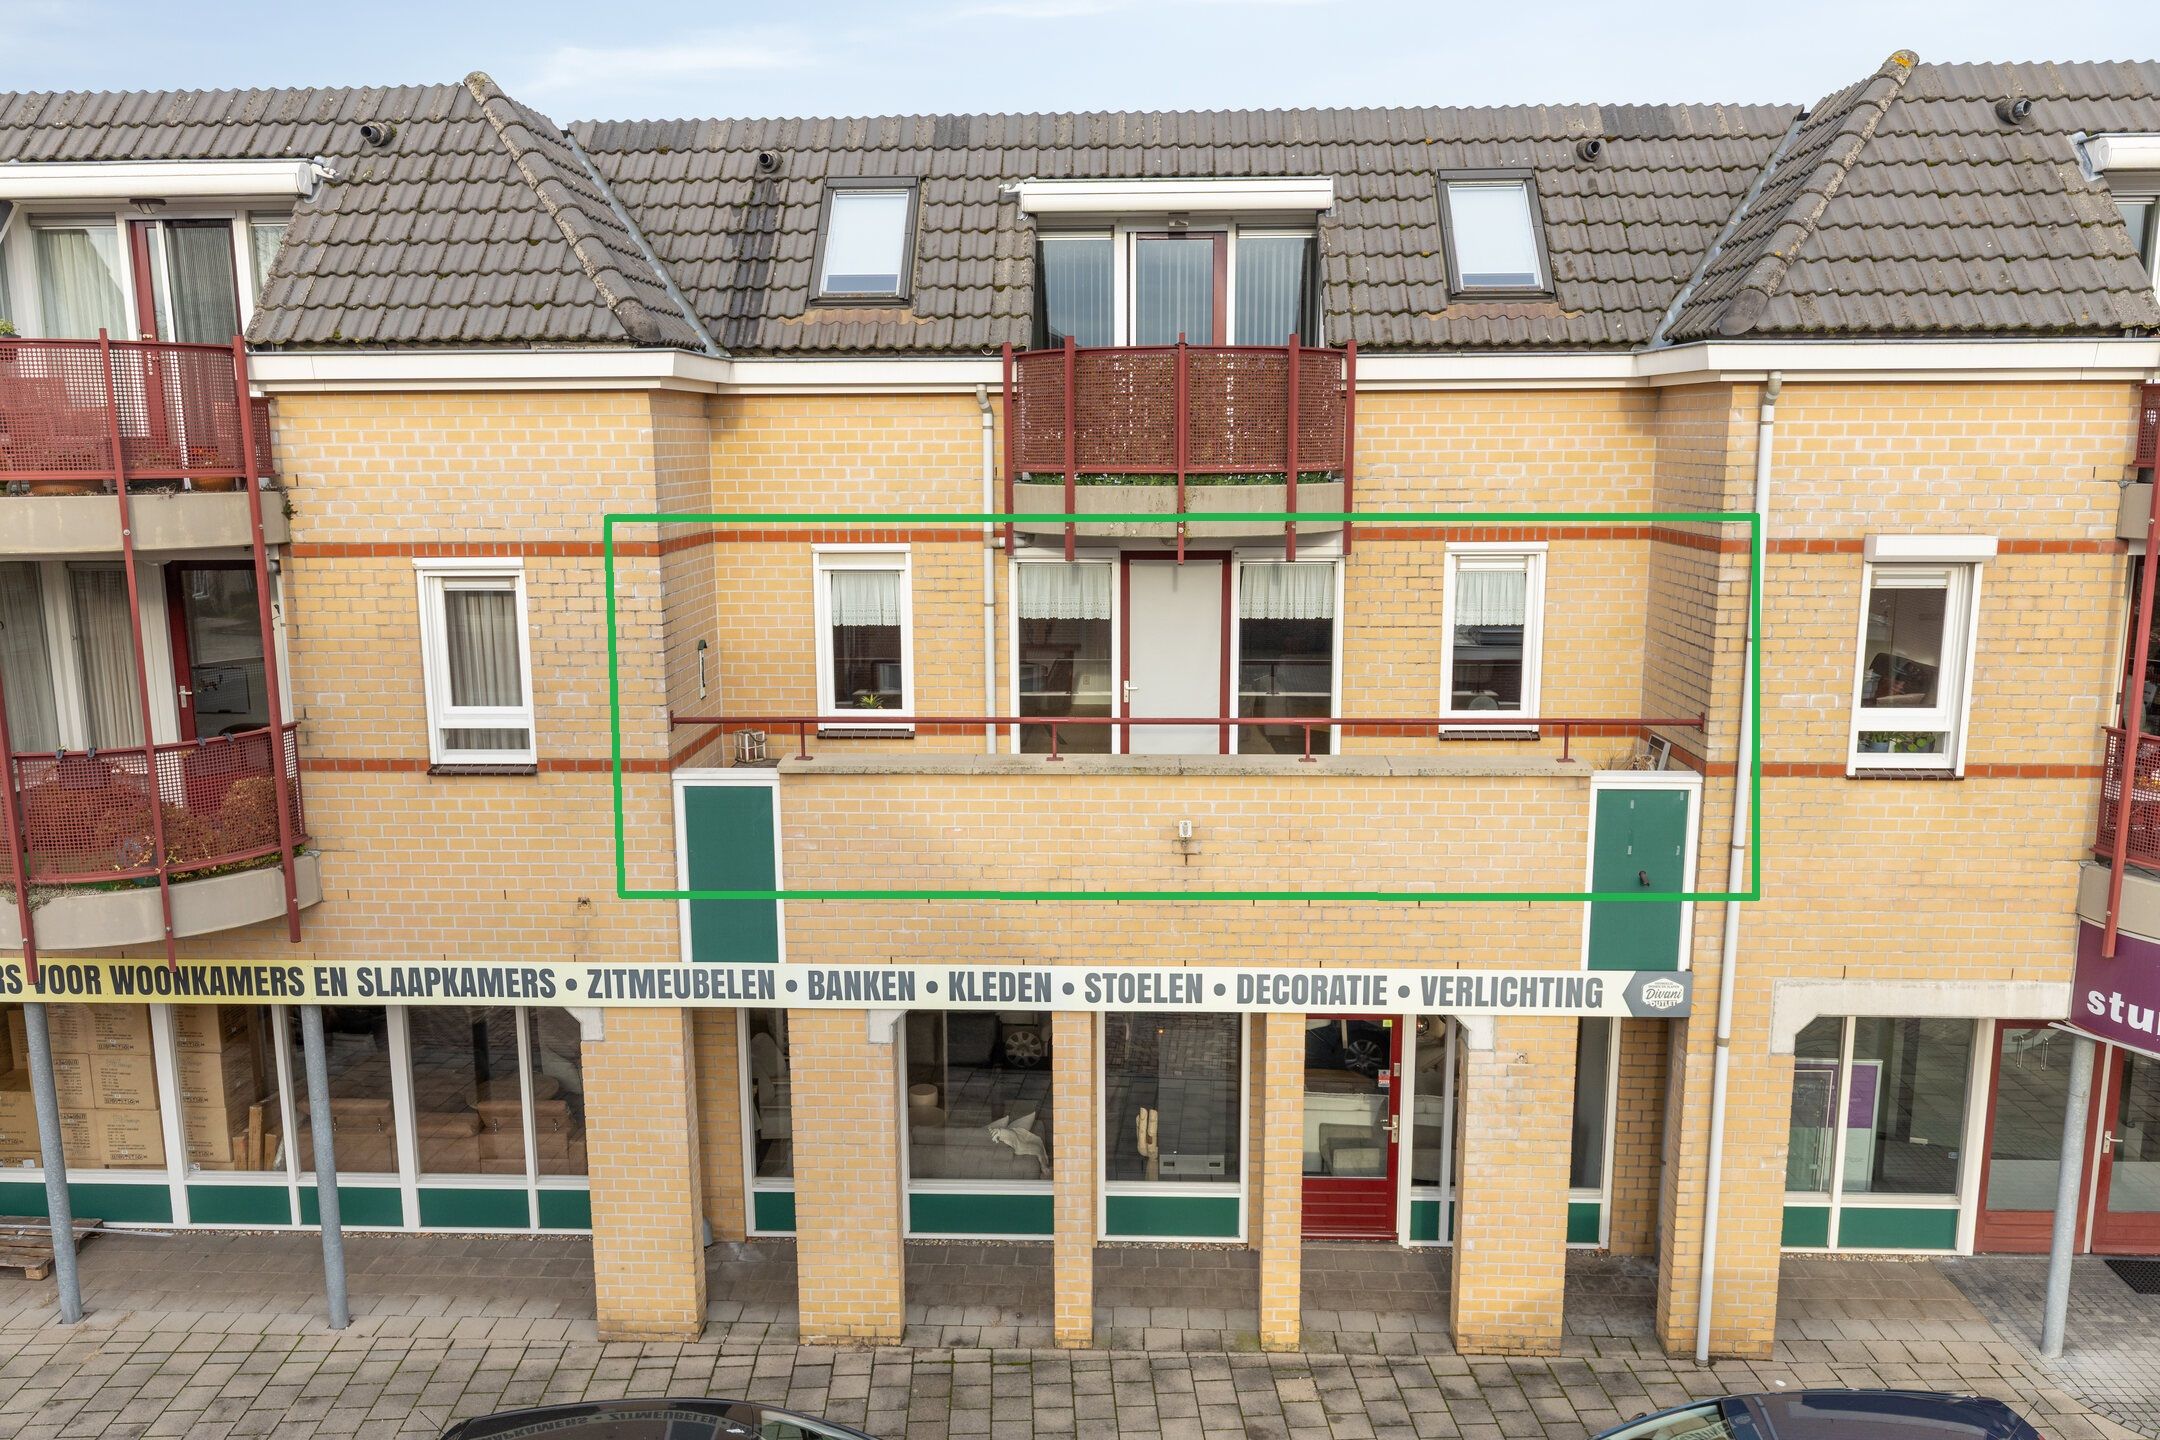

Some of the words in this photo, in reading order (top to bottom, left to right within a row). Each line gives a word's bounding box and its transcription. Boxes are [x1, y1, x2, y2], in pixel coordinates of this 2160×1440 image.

[108, 965, 305, 997] WOONKAMERS
[313, 966, 349, 997] EN
[357, 966, 556, 999] SLAAPKAMERS
[586, 968, 776, 1000] ZITMEUBELEN
[807, 970, 915, 1002] BANKEN
[948, 971, 1052, 1002] KLEDEN
[1084, 972, 1203, 1004] STOELEN
[1236, 973, 1388, 1006] DECORATIE
[1420, 975, 1603, 1009] VERLICHTING
[1646, 988, 1682, 1000] Divani
